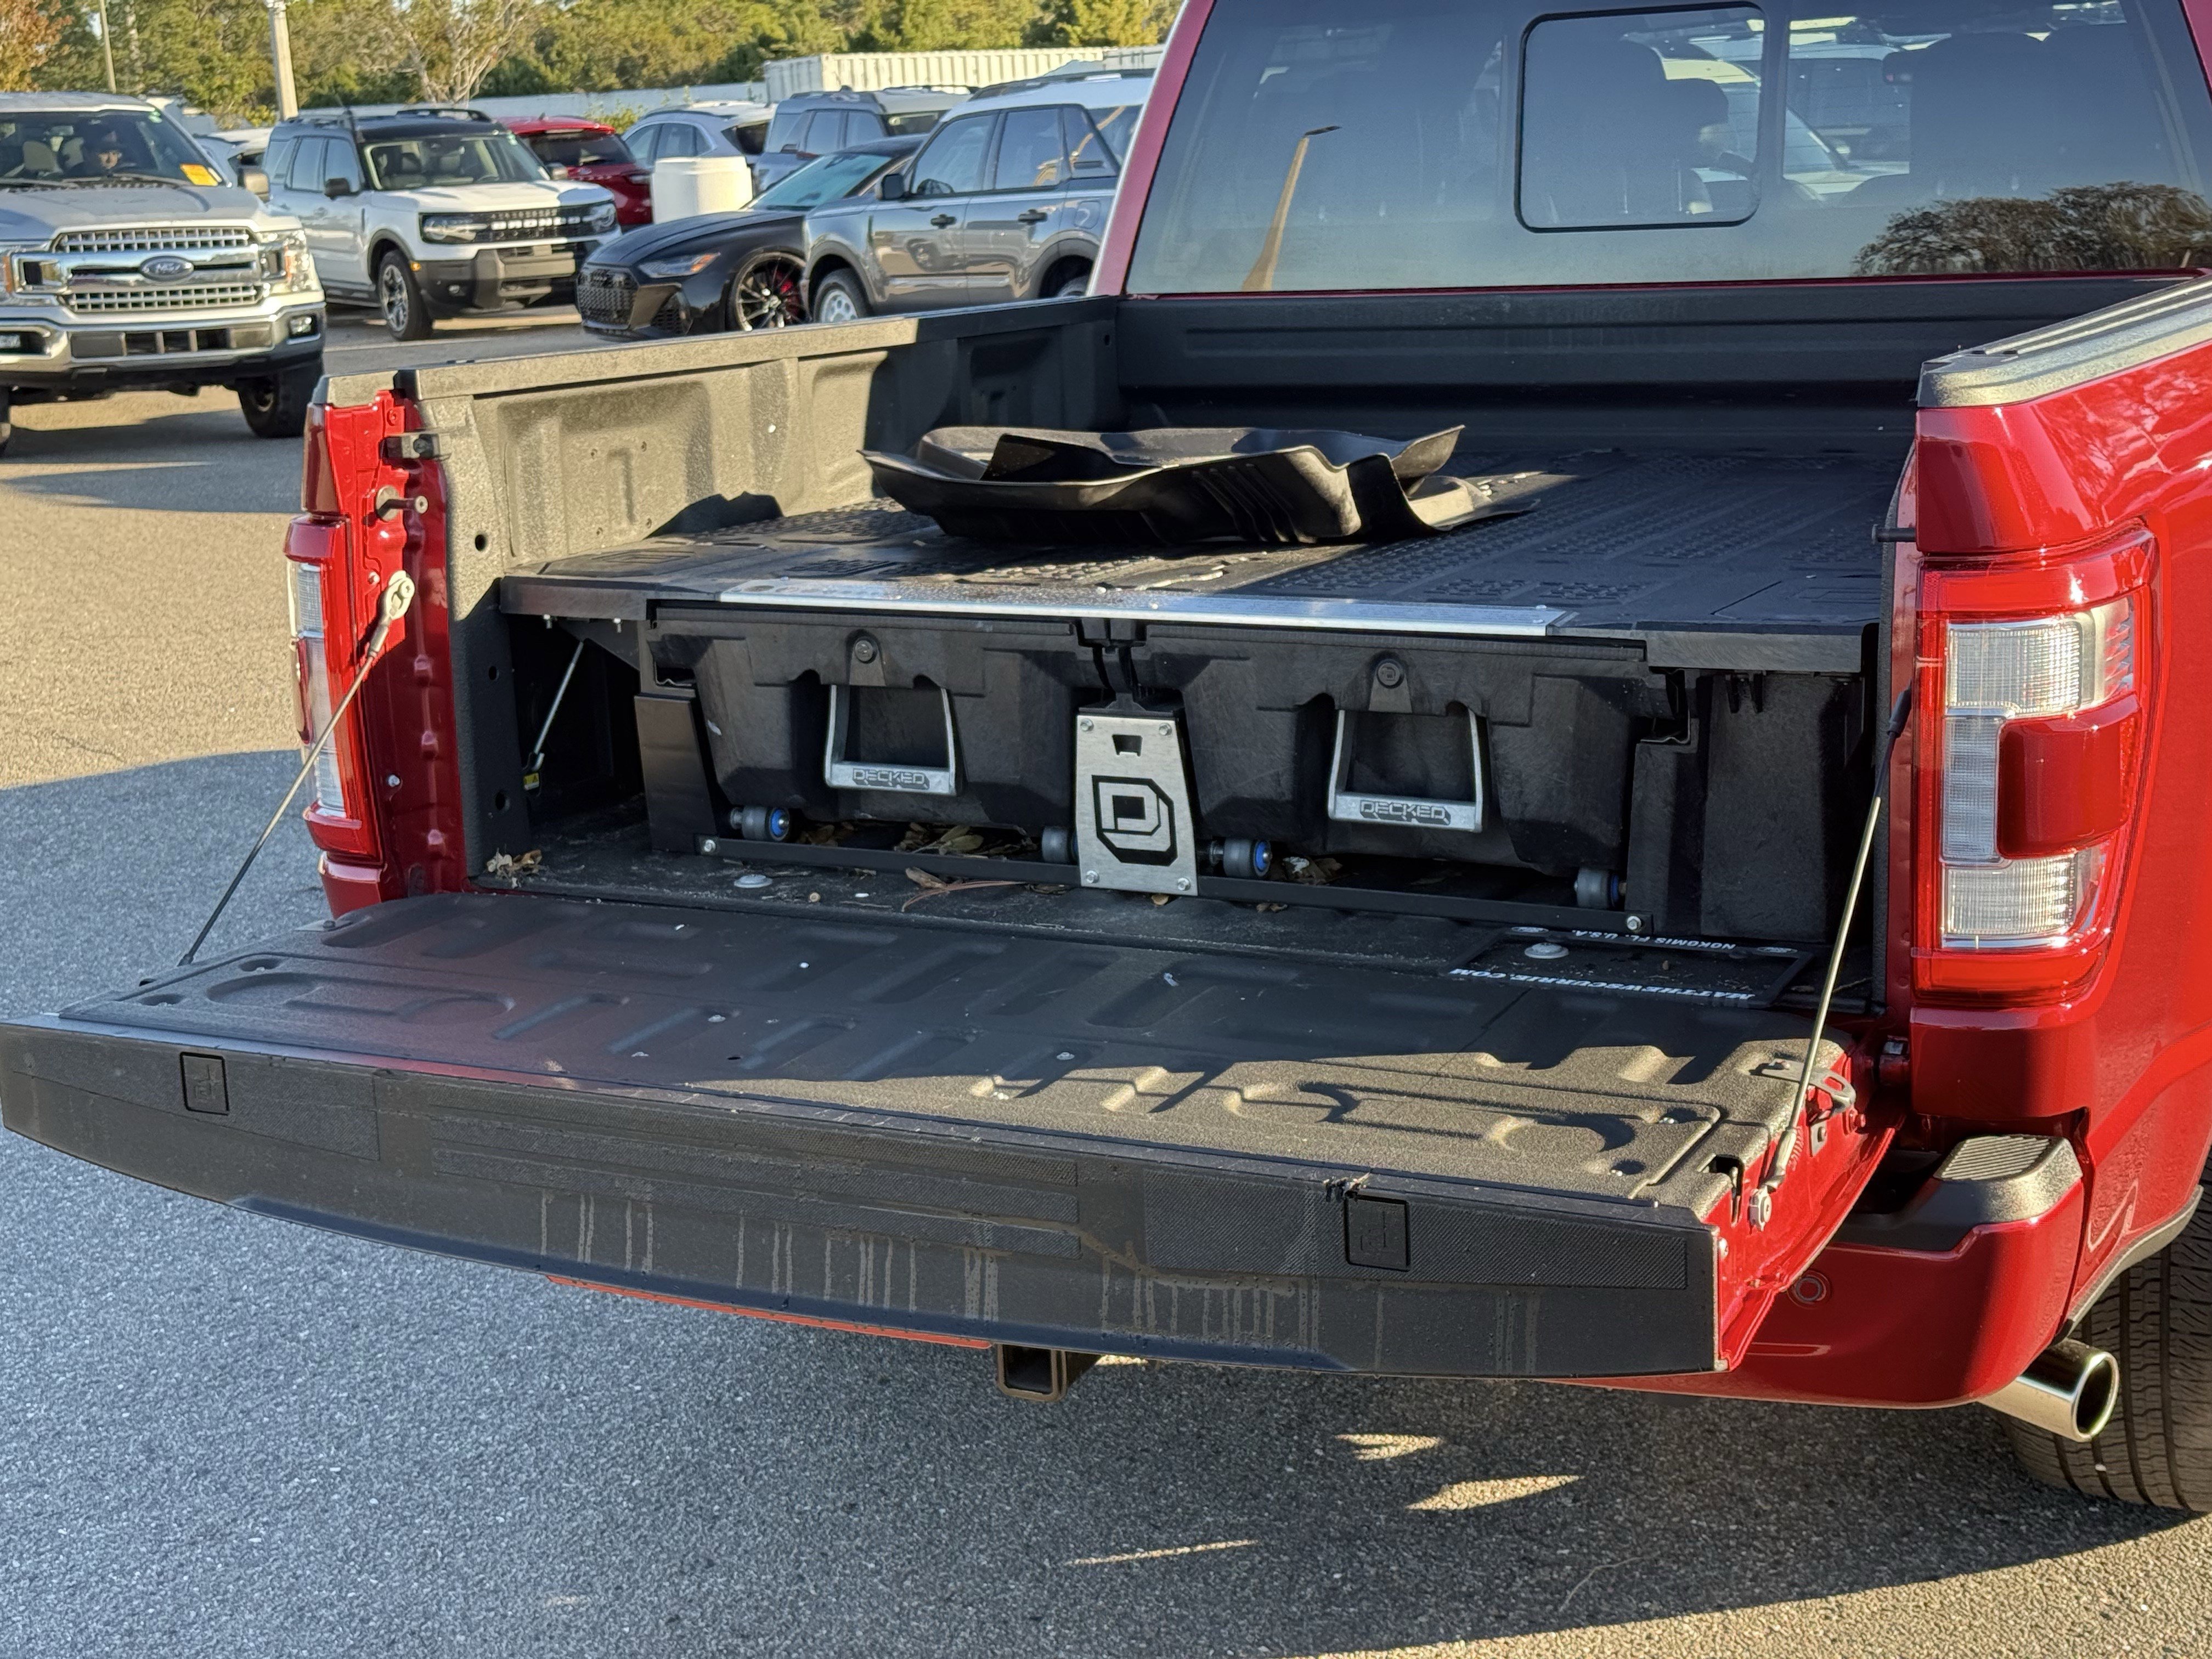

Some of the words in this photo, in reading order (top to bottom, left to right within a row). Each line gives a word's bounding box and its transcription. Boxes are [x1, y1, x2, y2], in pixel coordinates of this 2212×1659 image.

[853, 768, 929, 789] DECKED
[1360, 800, 1450, 824] DECKED
[1572, 929, 1618, 940] U.S.A.
[1654, 937, 1736, 950] NOKOMIS
